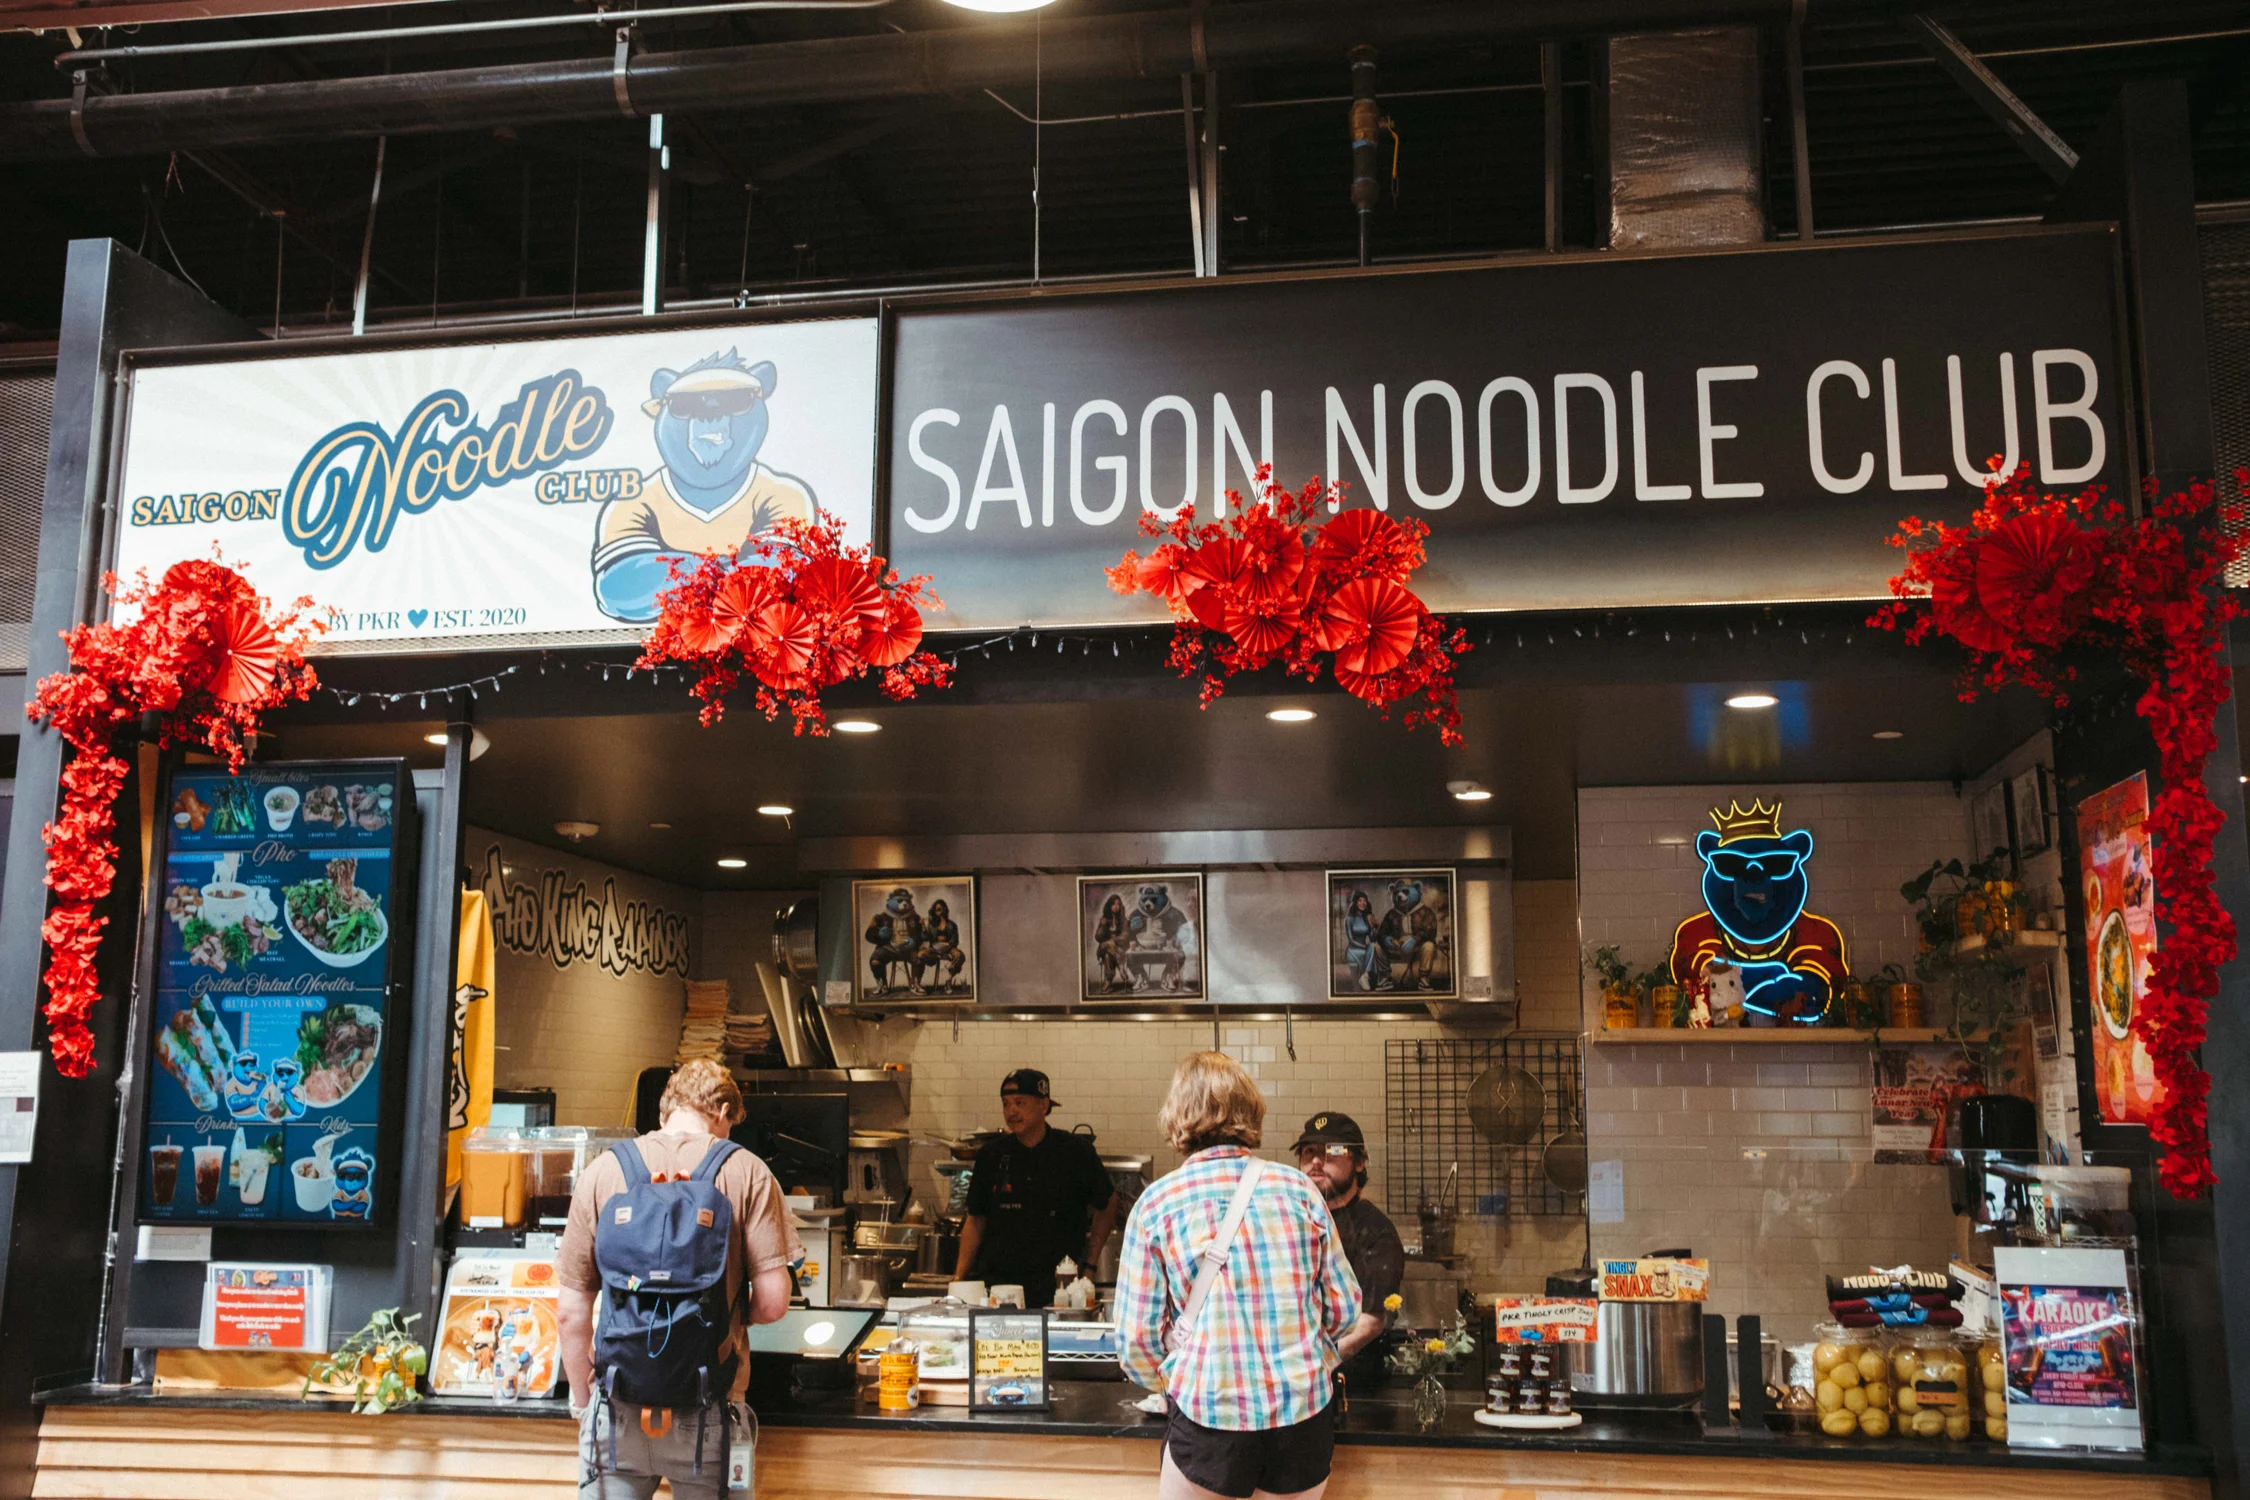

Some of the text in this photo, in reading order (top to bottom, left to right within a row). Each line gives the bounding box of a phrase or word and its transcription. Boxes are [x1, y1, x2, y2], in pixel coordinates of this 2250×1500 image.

[903, 346, 2109, 535] SAIGON NOODLE CLUB
[282, 368, 614, 571] Noodle
[535, 468, 642, 504] CLUB
[131, 488, 281, 527] SAIGON
[331, 608, 526, 632] BY PKR EST. 2020
[252, 840, 298, 867] Pho
[188, 972, 356, 998] Grilled Salad Noodles
[225, 998, 324, 1009] BUILD YOUR OWN
[1876, 1087, 1929, 1096] Celebrate
[1873, 1099, 1908, 1107] Lunar
[1890, 1109, 1917, 1118] Year
[194, 1115, 238, 1134] Drinks
[320, 1116, 351, 1134] Kids
[1604, 1261, 1637, 1274] TINGLY
[1604, 1274, 1655, 1298] SNAX
[1906, 1270, 1948, 1289] Club
[1502, 1312, 1521, 1322] PKR
[1523, 1309, 1552, 1320] TINGLY
[1554, 1306, 1577, 1317] CRISP
[2018, 1300, 2111, 1325] KARAOKE
[2039, 1339, 2099, 1351] FAMILY NIGHT
